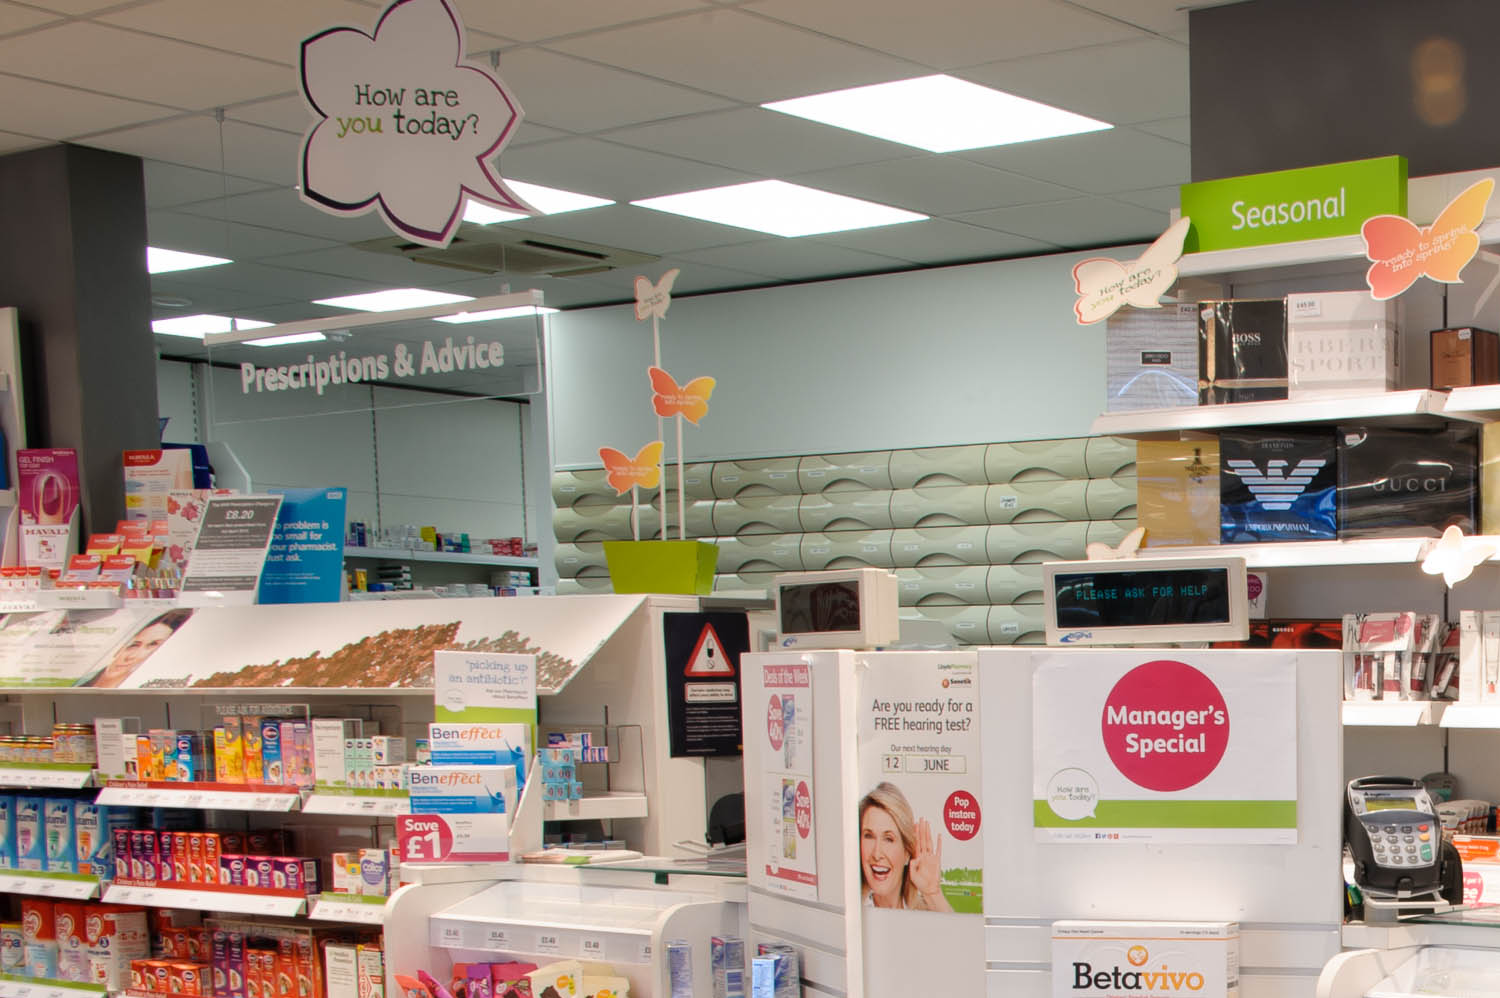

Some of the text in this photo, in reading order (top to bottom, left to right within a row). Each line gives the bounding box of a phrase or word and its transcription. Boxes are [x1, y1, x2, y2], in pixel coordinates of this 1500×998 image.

[354, 84, 460, 107] How are
[336, 108, 480, 141] you today?
[1232, 187, 1345, 230] Seasonal
[1099, 268, 1152, 296] How are
[1232, 333, 1261, 343] BOSS
[240, 336, 505, 396] Prescriptions & Advice
[1291, 355, 1382, 372] SPORT
[1372, 478, 1446, 491] GUCCI
[225, 510, 255, 520] £8.20
[283, 521, 329, 530] problem is
[285, 532, 322, 540] small for
[1076, 585, 1208, 600] PLEASE ASK FOR HELP
[514, 664, 528, 673] up
[764, 669, 777, 684] Deals
[793, 668, 809, 684] Week
[449, 675, 463, 684] an
[768, 700, 783, 721] Save
[872, 699, 973, 716] Are you ready for a
[431, 727, 504, 741] Beneffect
[874, 718, 971, 735] FREE hearing test?
[891, 744, 901, 752] Our
[916, 744, 938, 754] hearing
[940, 745, 952, 754] day
[1125, 733, 1206, 758] Special
[924, 758, 950, 771] JUNE
[411, 771, 482, 786] Beneffect
[1057, 785, 1073, 793] How
[796, 791, 810, 809] Save
[953, 796, 970, 809] Pop
[949, 809, 976, 820] instore
[405, 819, 439, 832] Save
[951, 822, 975, 834] today
[407, 831, 442, 859] £1
[1072, 962, 1205, 991] Betavivo
